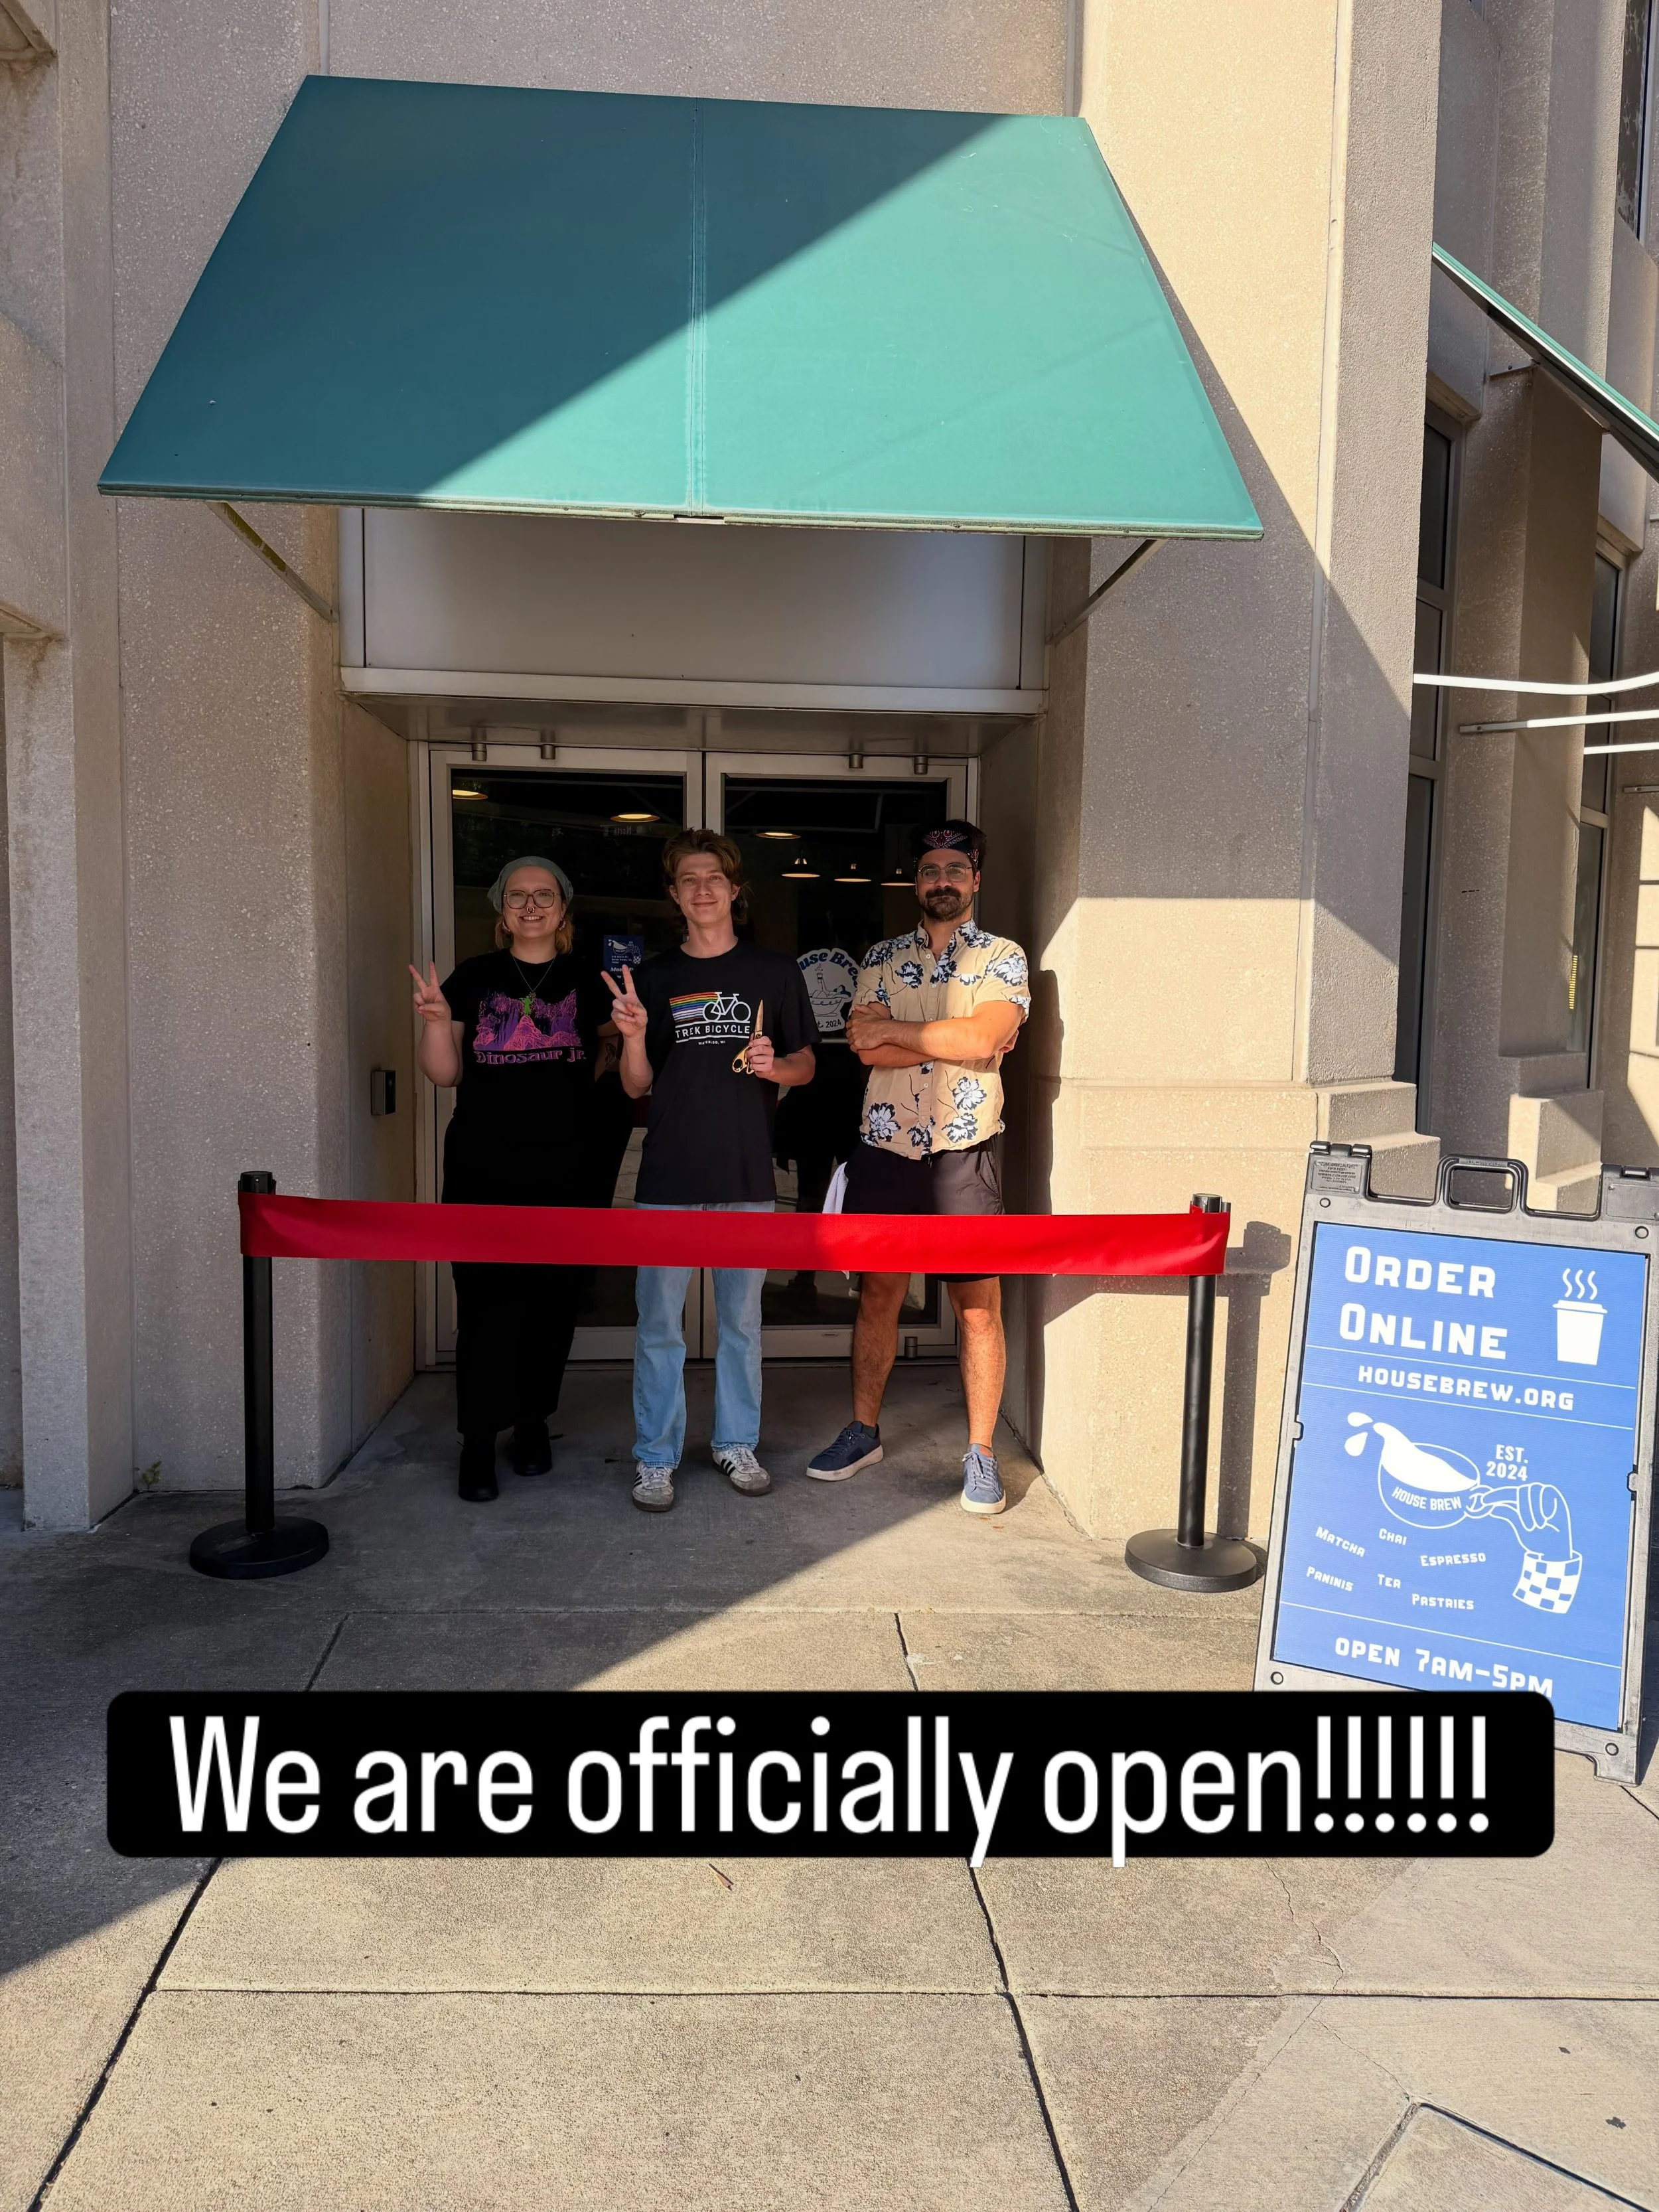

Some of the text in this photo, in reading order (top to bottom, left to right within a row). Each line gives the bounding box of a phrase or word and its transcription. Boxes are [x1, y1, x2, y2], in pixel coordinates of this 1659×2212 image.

[798, 952, 828, 970] use
[675, 1024, 751, 1039] TREK BICYCLE
[826, 1019, 842, 1028] 2024
[473, 1050, 563, 1065] Dinosaur
[1344, 1246, 1496, 1298] ORDER
[1339, 1302, 1508, 1360] ONLINE
[1358, 1364, 1575, 1411] HOUSEBREW.ORG
[1495, 1443, 1528, 1464] EST.
[1486, 1460, 1528, 1481] 2024
[1391, 1486, 1462, 1511] HOUSE BREW
[1420, 1552, 1486, 1567] ESPRESSO
[1306, 1566, 1354, 1591] PANINIS
[1411, 1593, 1475, 1610] PASTRIES
[1334, 1637, 1553, 1698] OPEN 7AM-5PM
